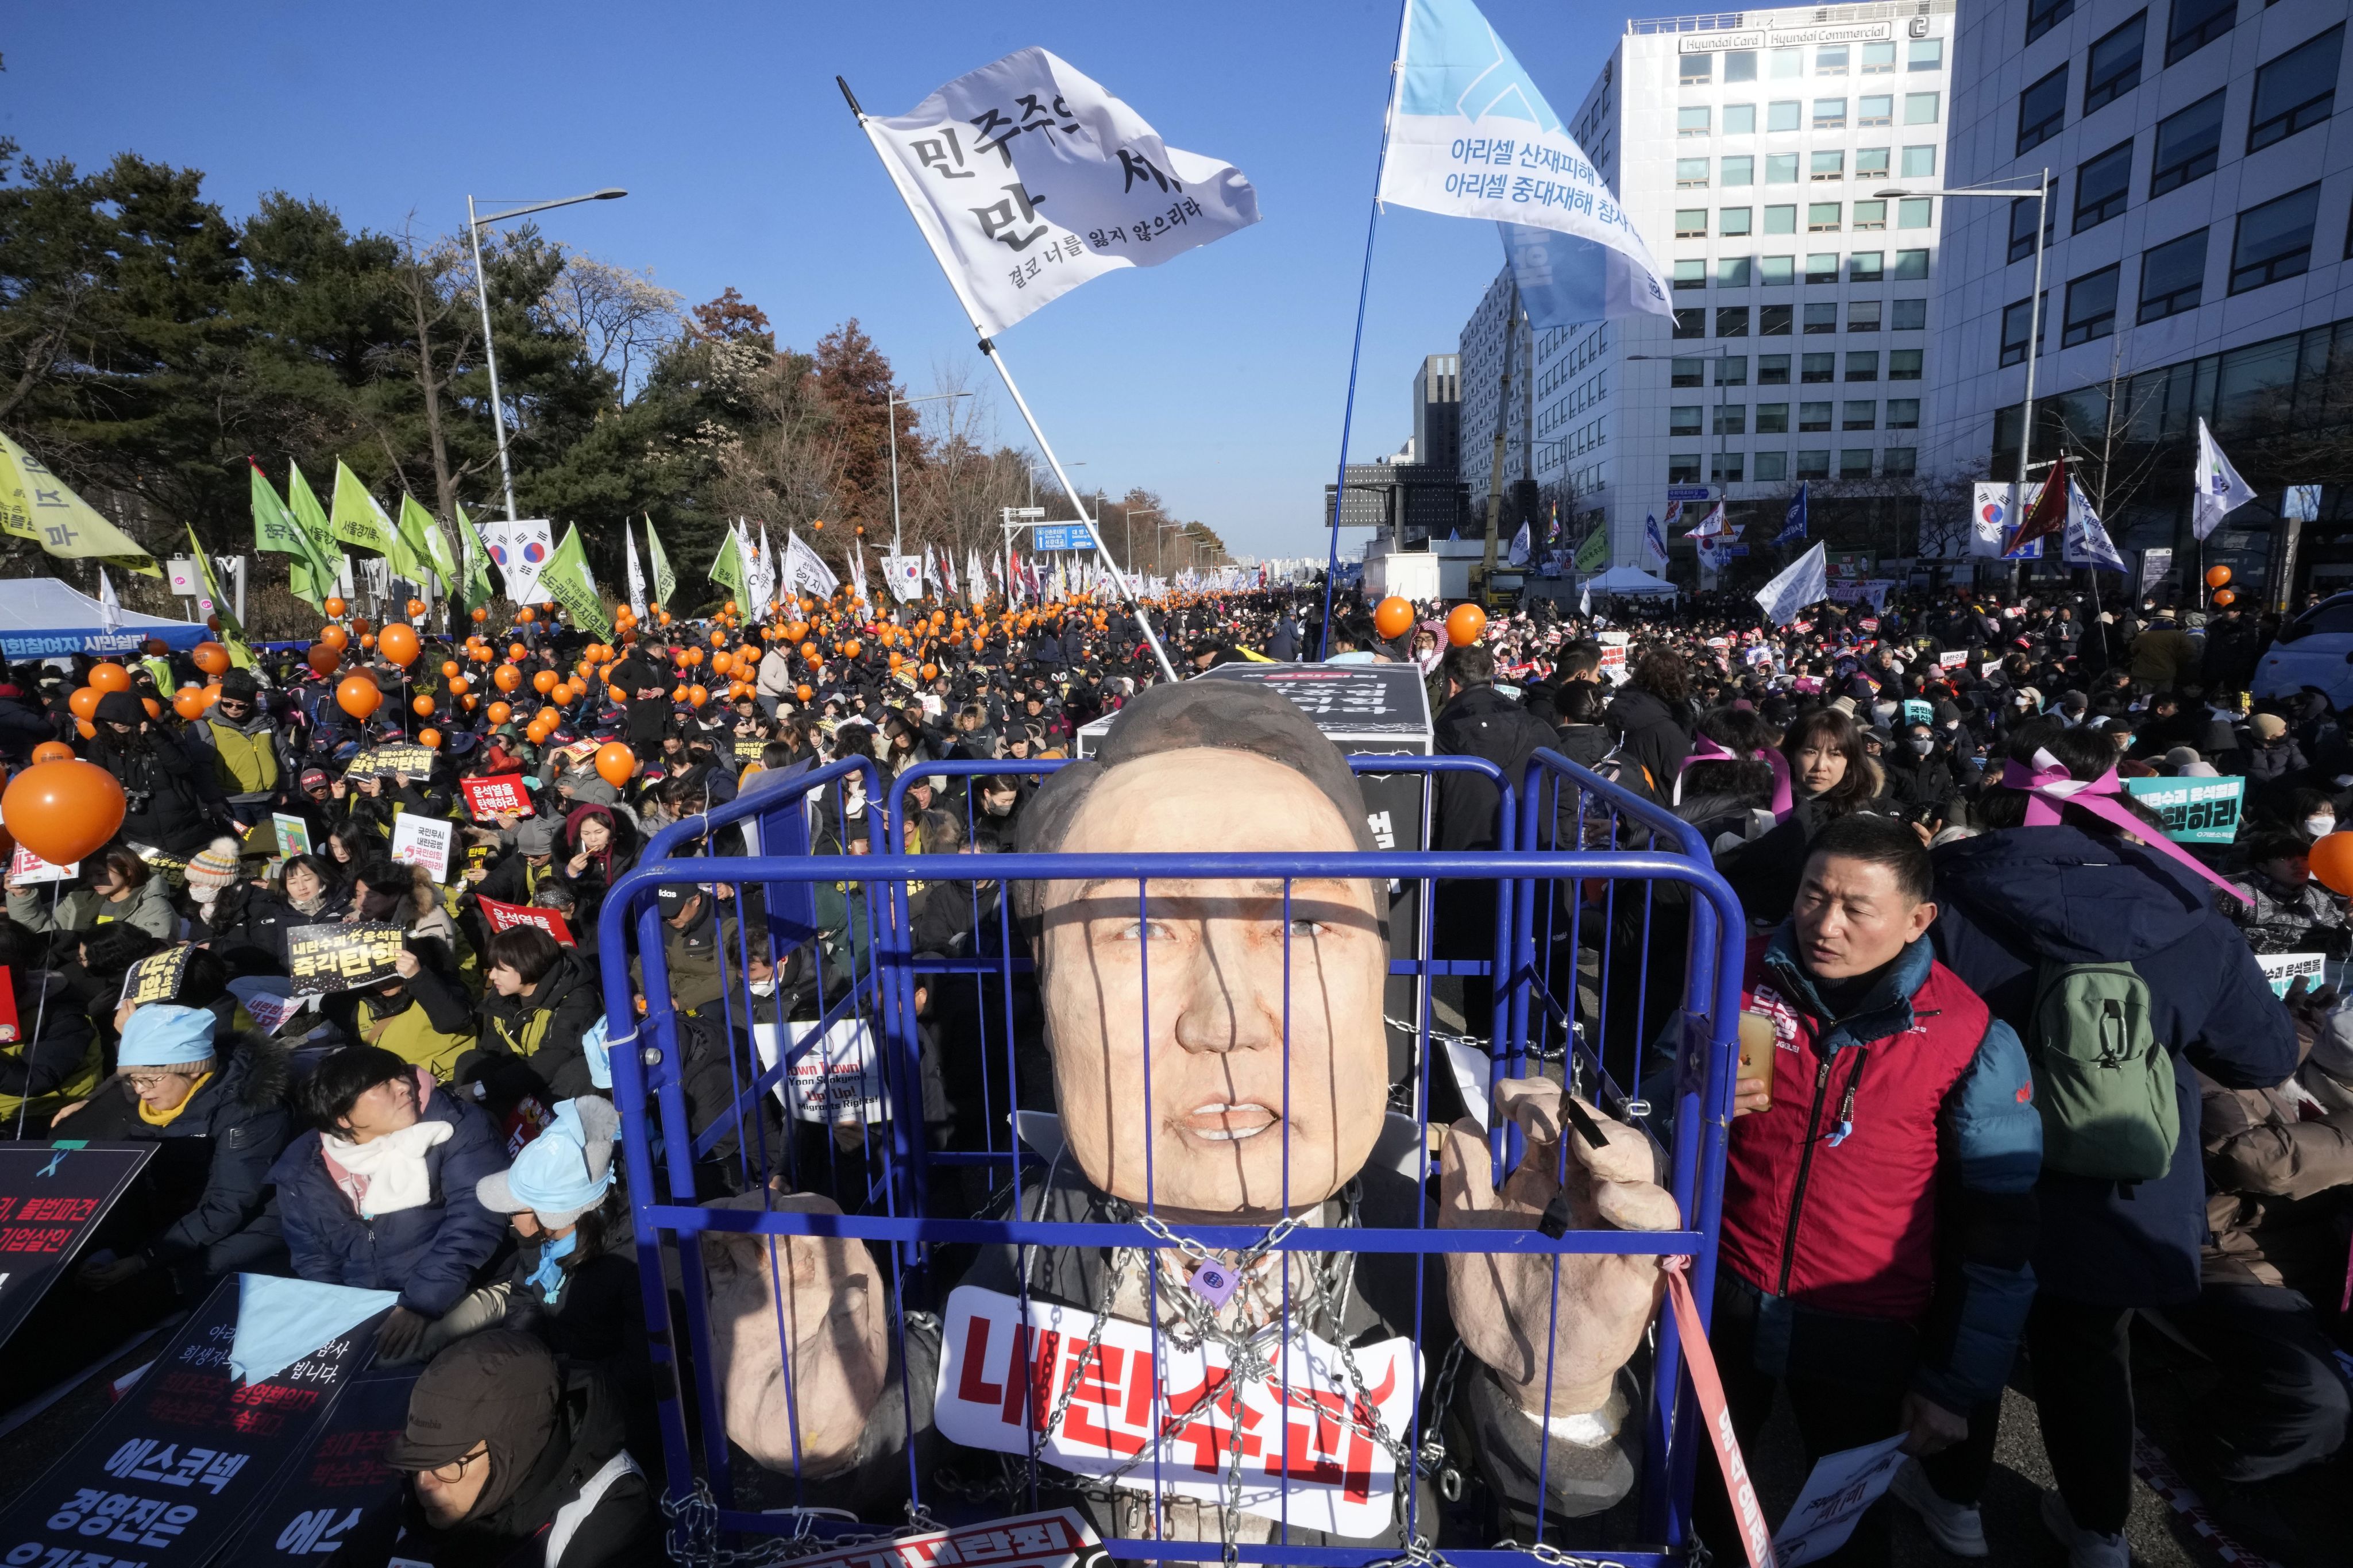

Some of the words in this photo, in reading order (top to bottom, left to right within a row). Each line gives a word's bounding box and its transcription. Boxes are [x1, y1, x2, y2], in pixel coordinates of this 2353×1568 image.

[1687, 37, 1731, 52] Hyundai
[1734, 36, 1758, 47] Card
[1771, 30, 1817, 45] Hyundai
[1819, 25, 1885, 40] Commercial
[1451, 138, 1515, 165] 아리셀
[1519, 142, 1595, 187] 산재피해
[1445, 172, 1509, 199] 아리셀
[1512, 176, 1594, 217] 중대재해
[1598, 198, 1629, 233] 참사
[1008, 257, 1042, 289] 결코
[1043, 234, 1082, 264] 너를
[1088, 226, 1128, 248] 잃지
[1132, 196, 1203, 242] 않으리라
[412, 749, 432, 758] 윤석열
[376, 757, 398, 768] 즉각
[397, 756, 431, 773] 탄핵
[472, 783, 514, 798] 윤석열을
[2190, 782, 2240, 802] 윤석열을
[477, 795, 519, 810] 탄핵하라
[2160, 798, 2237, 832] 핵하라
[418, 827, 445, 840] 국민무시
[417, 837, 443, 850] 내란공범
[468, 847, 488, 858] 탄핵
[415, 847, 442, 860] 국민의힘
[293, 935, 347, 955] 내란수괴
[362, 930, 402, 943] 윤석열
[293, 952, 340, 976] 즉각
[338, 941, 403, 978] 탄핵
[2286, 959, 2321, 977] 윤석열을
[248, 999, 283, 1015] 내란범
[787, 1065, 817, 1076] own
[788, 1076, 815, 1086] Yoon
[831, 1086, 858, 1099] Up!
[16, 1197, 100, 1221] 불법파견
[290, 1361, 338, 1384] 빕니다.
[230, 1381, 320, 1412] 경영책임자
[957, 1316, 1397, 1505] 내란수괴
[103, 1437, 251, 1495] 에스코넥
[46, 1487, 199, 1549] 경영진은
